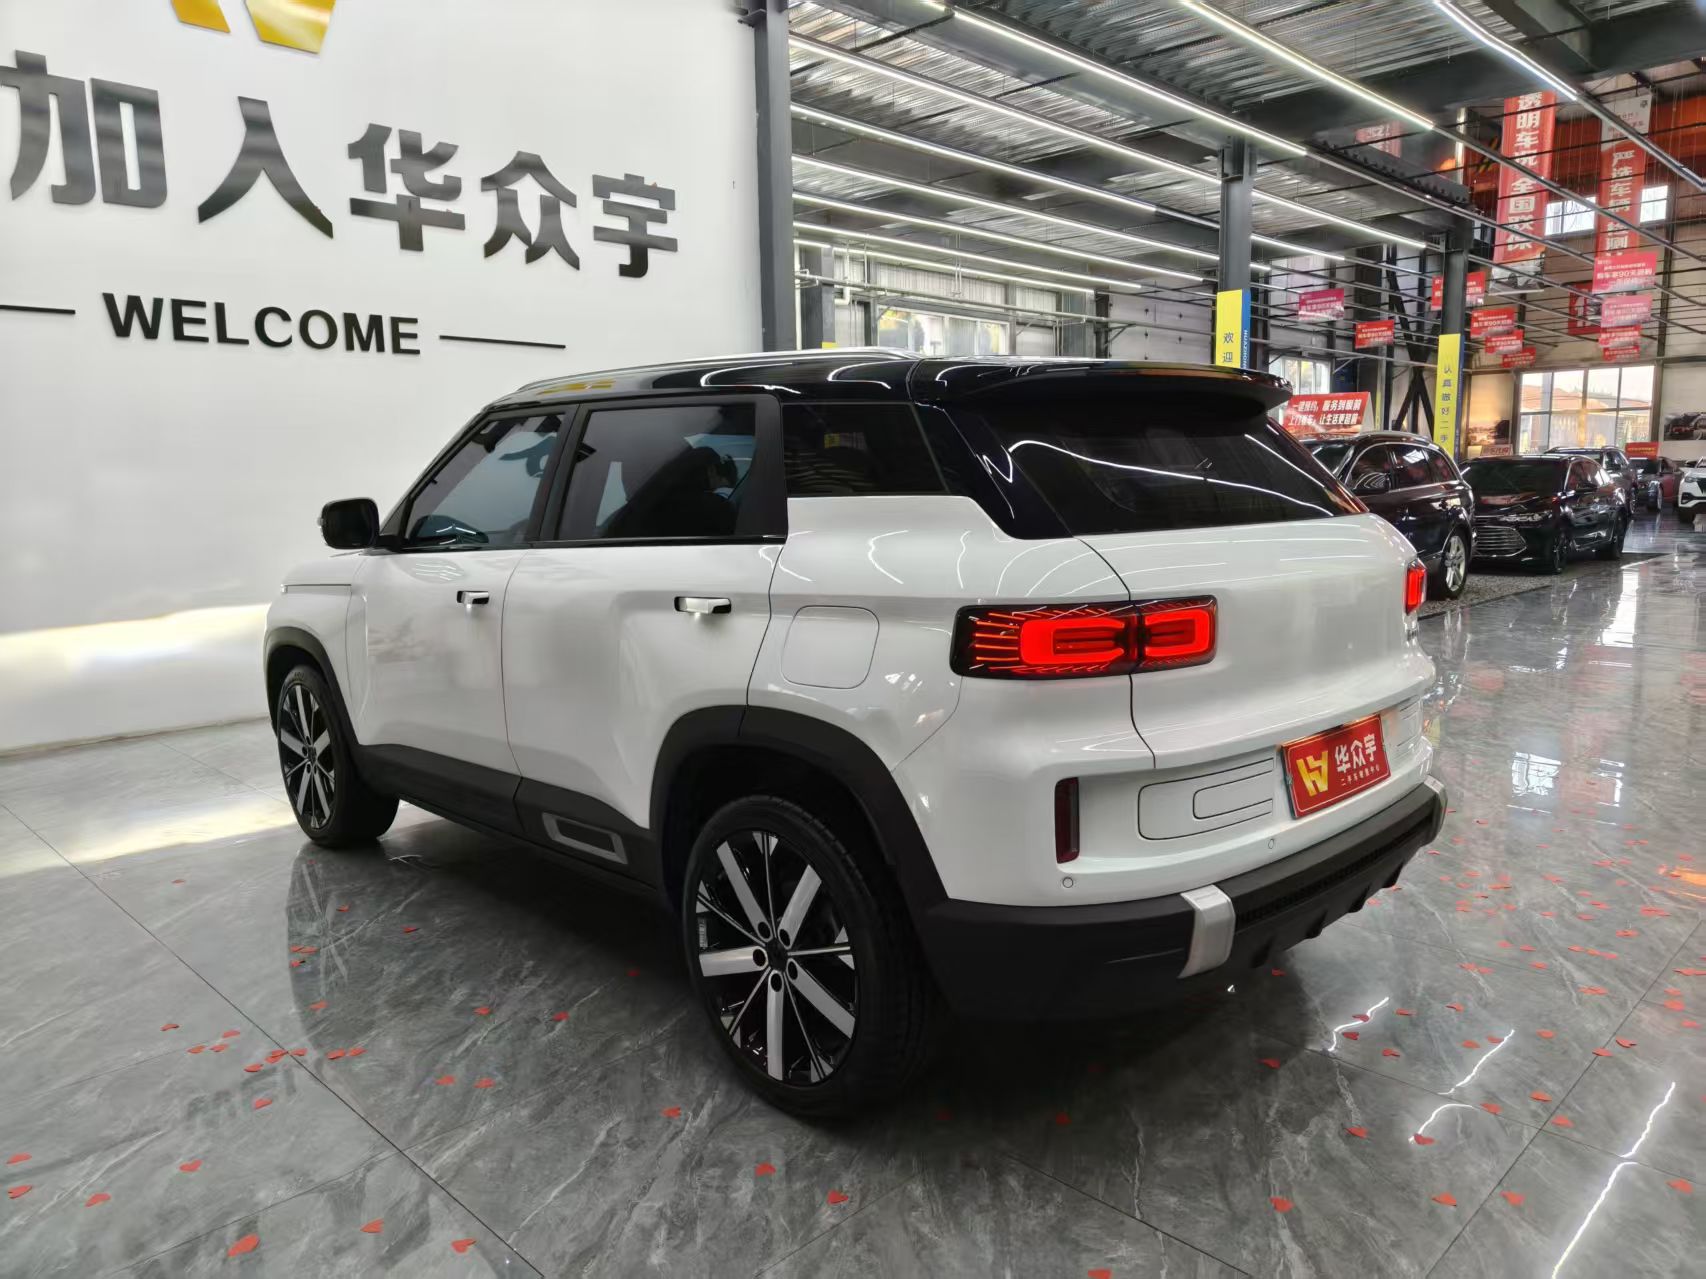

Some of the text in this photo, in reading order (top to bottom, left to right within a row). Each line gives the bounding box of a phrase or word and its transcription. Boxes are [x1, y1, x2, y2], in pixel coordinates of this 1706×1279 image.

[0, 50, 678, 278] 加入华众宇
[102, 292, 421, 356] WELCOME
[1223, 332, 1234, 363] 欢迎
[1335, 733, 1377, 773] 华众宇
